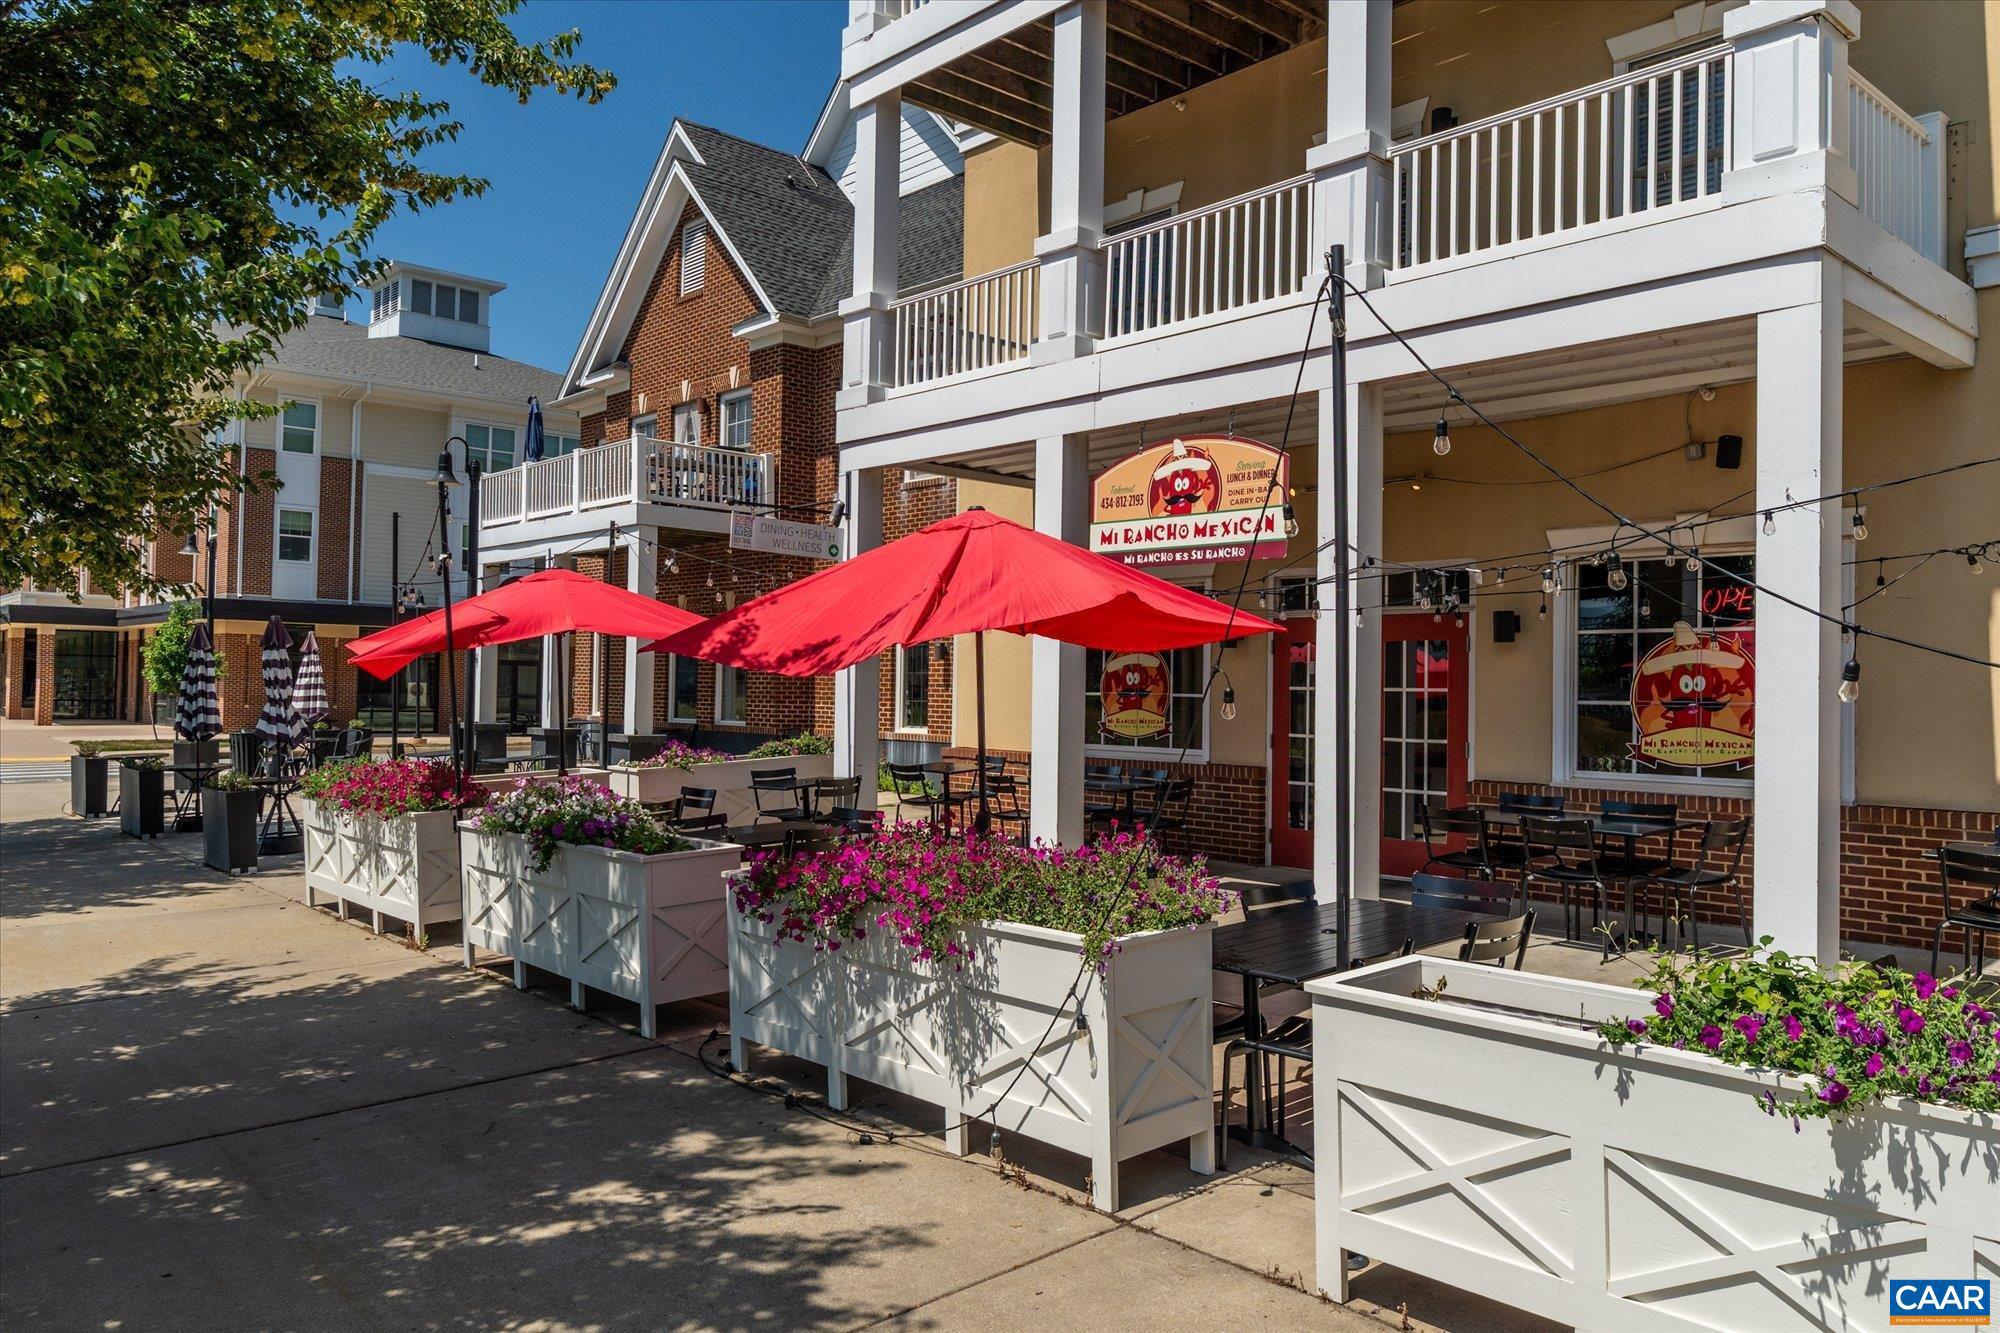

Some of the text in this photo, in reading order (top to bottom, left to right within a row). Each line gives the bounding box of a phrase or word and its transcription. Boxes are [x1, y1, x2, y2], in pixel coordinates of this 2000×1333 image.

[1236, 460, 1266, 471] Serving
[1227, 471, 1246, 483] LUNCH
[1246, 470, 1252, 481] &
[1110, 484, 1136, 495] Takeout
[1228, 488, 1245, 497] DINE
[1229, 496, 1268, 506] CARRY OU
[759, 522, 836, 543] DINING HEALTH
[1123, 523, 1190, 545] RANCHO
[1193, 513, 1275, 539] MEXICAN
[772, 537, 823, 554] WELLNESS
[1136, 552, 1174, 564] RANCHO
[1190, 549, 1204, 560] SU
[1205, 547, 1246, 560] RANCHO
[1702, 587, 1752, 613] OPE
[1660, 739, 1700, 748] RANCHO
[1704, 739, 1753, 749] MEXICAN
